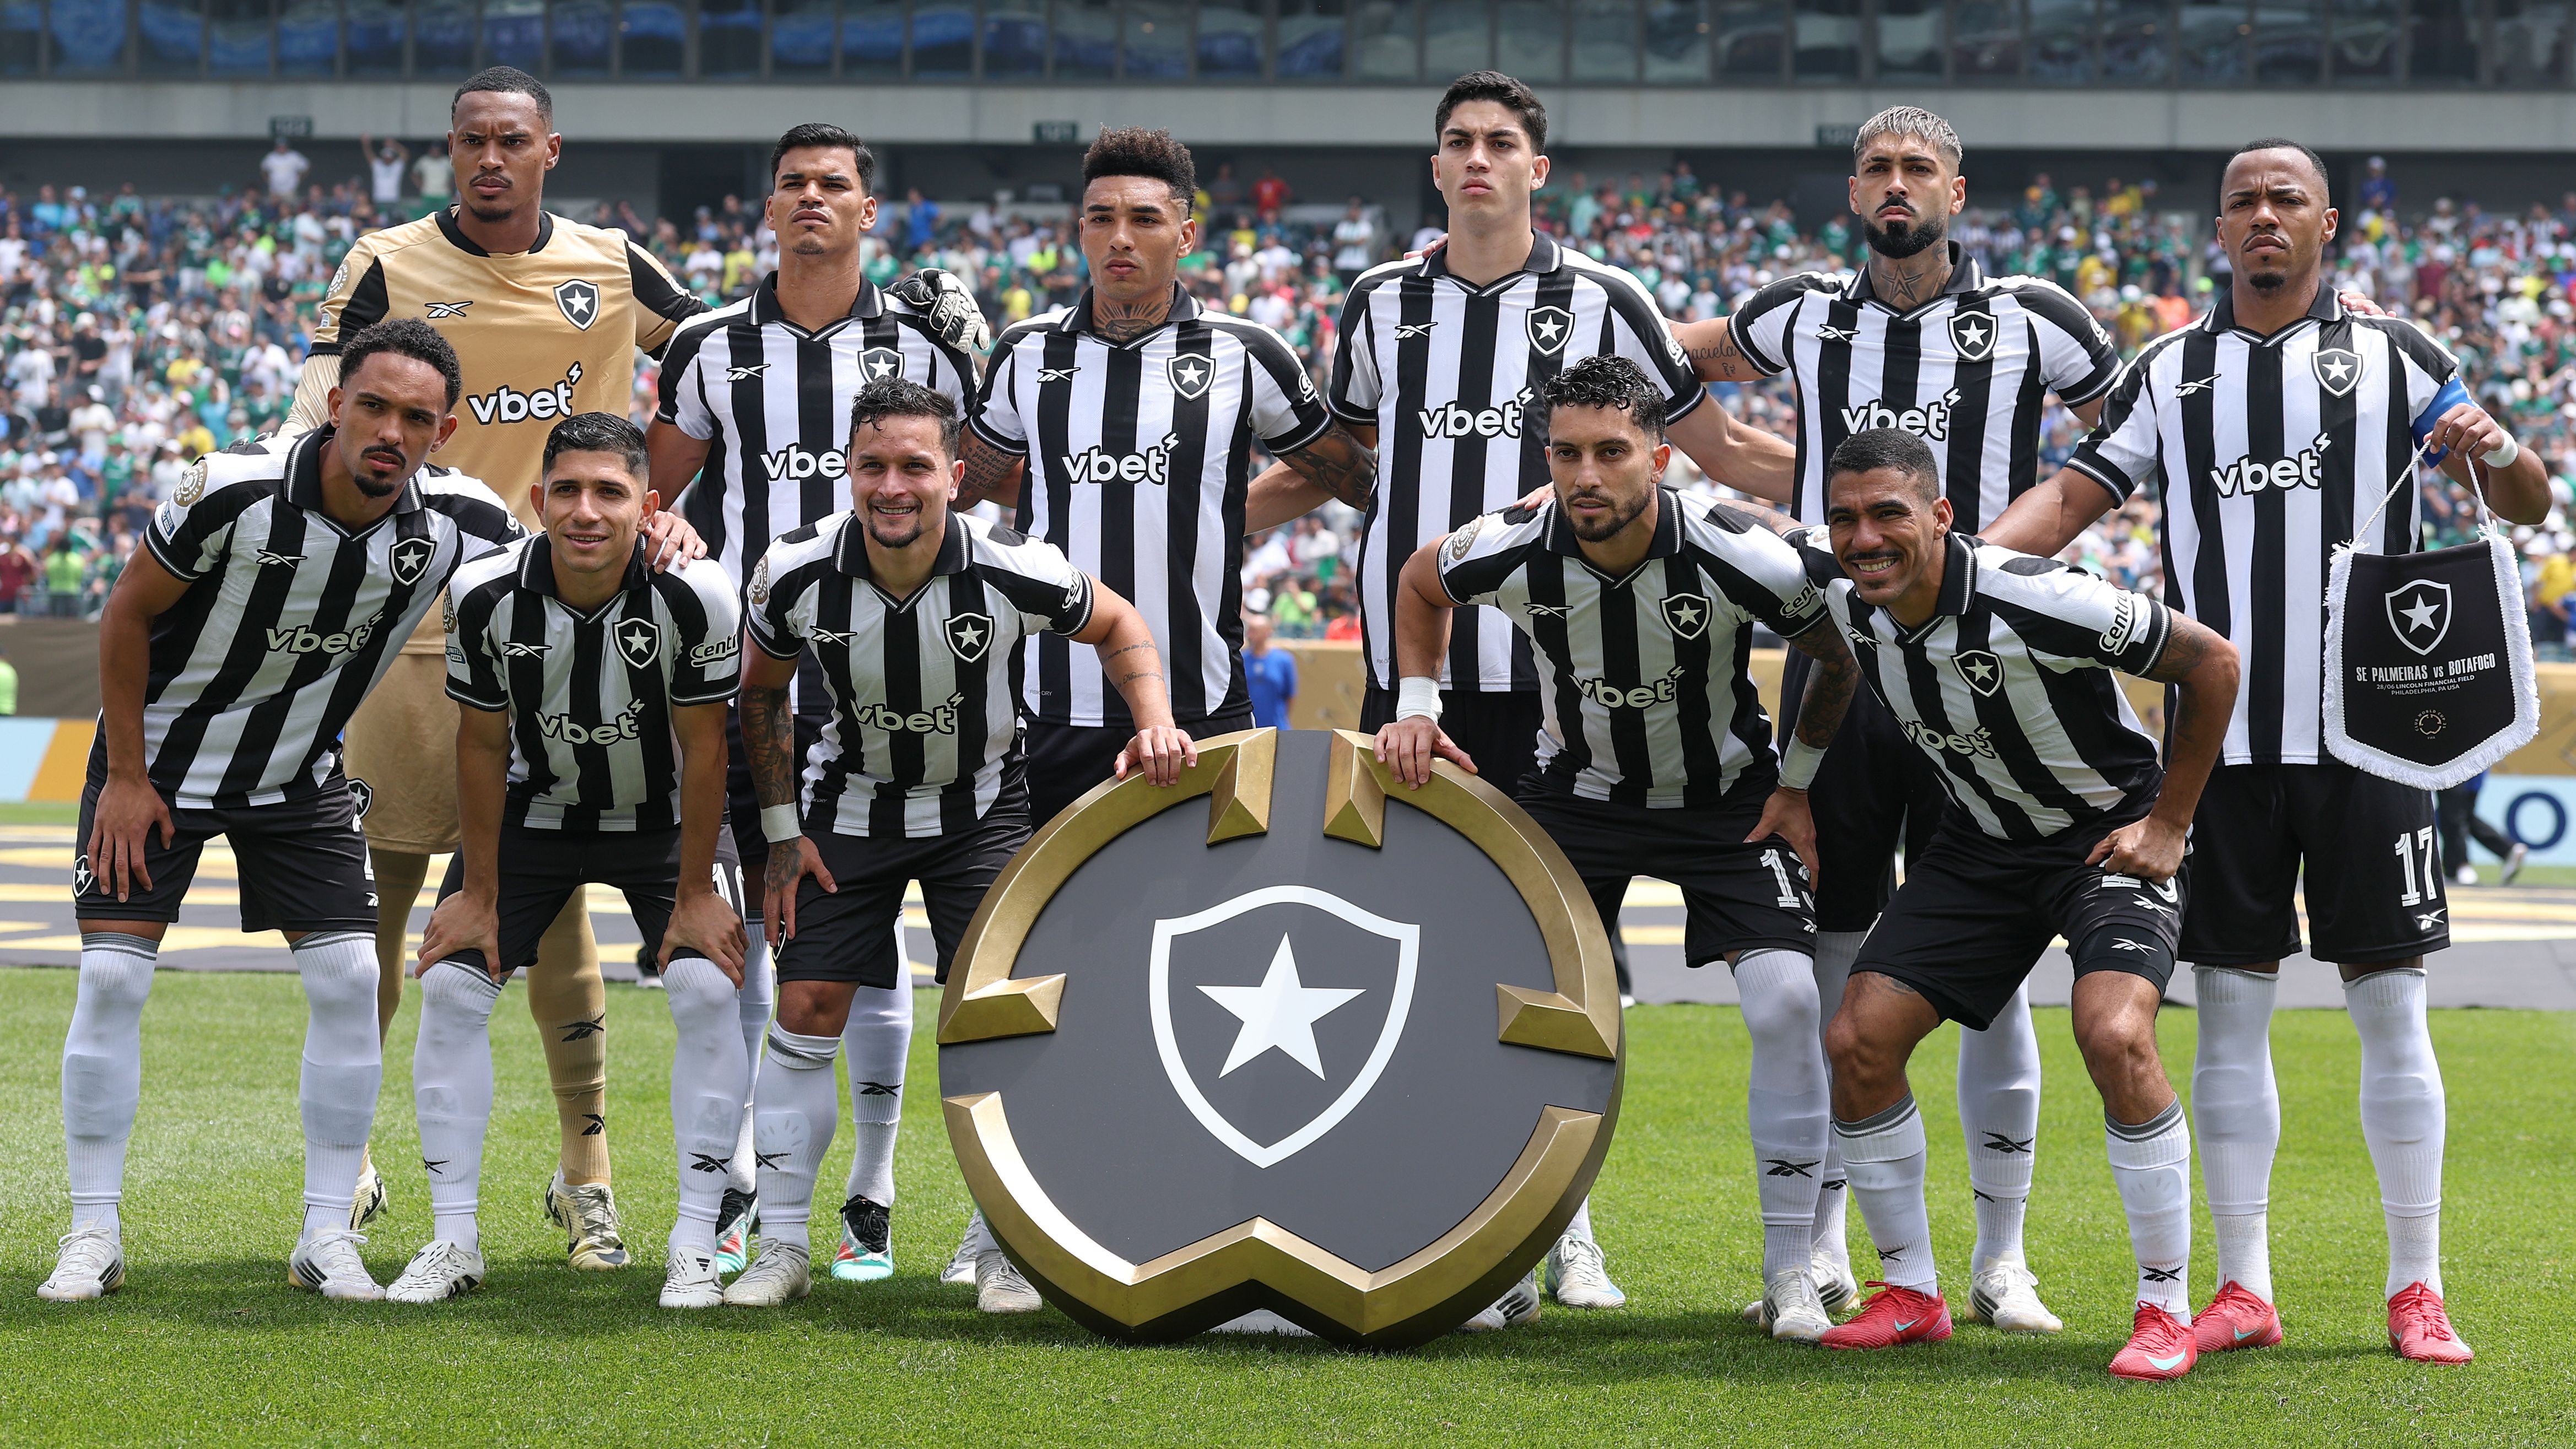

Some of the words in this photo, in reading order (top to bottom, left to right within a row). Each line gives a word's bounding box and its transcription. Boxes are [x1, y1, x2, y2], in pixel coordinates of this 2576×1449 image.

[468, 381, 571, 423] vbet
[1418, 403, 1520, 436] vbet
[1840, 402, 1946, 439] vbet
[760, 444, 849, 479] vbe
[1061, 447, 1164, 483] vbet
[2210, 451, 2319, 496] vbet
[266, 626, 369, 654] vbet
[2356, 667, 2368, 682] SE
[2372, 664, 2428, 682] PALMEIRAS
[2448, 652, 2496, 676] BOTAFOGO
[2424, 678, 2458, 687] FINANCIAL
[1568, 674, 1673, 708] vbet
[535, 711, 638, 745] vbet
[850, 698, 953, 732] vbet
[1894, 716, 1993, 758] vbet
[2395, 825, 2437, 907] 17
